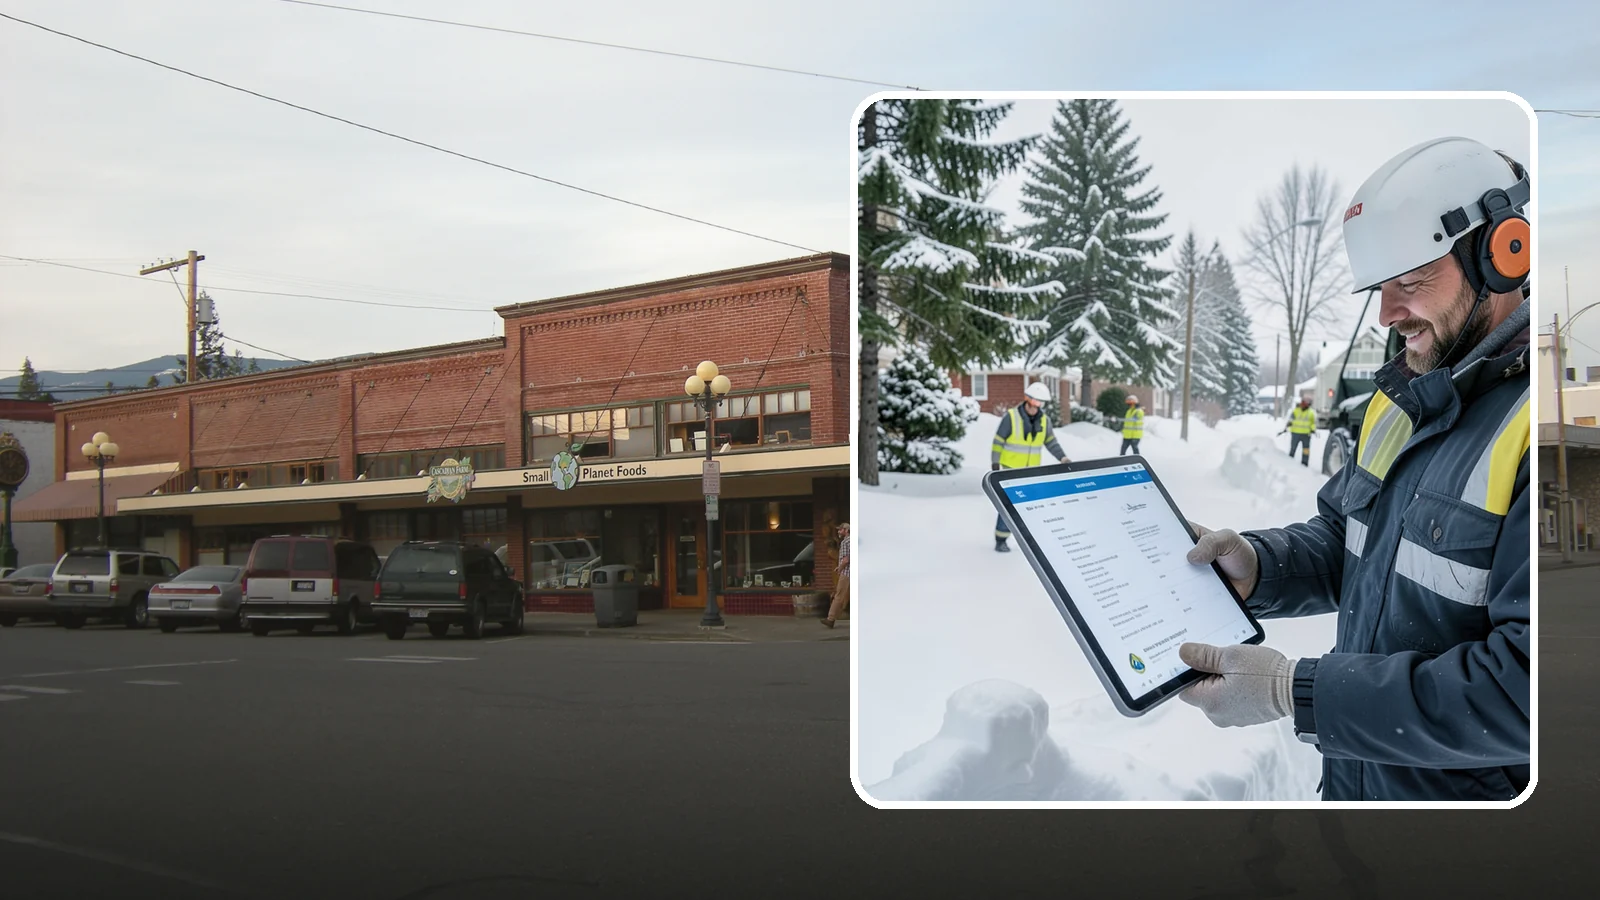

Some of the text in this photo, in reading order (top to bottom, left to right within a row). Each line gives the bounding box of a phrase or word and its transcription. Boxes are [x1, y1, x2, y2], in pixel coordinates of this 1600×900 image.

[523, 464, 646, 482] Small Planet Foods
